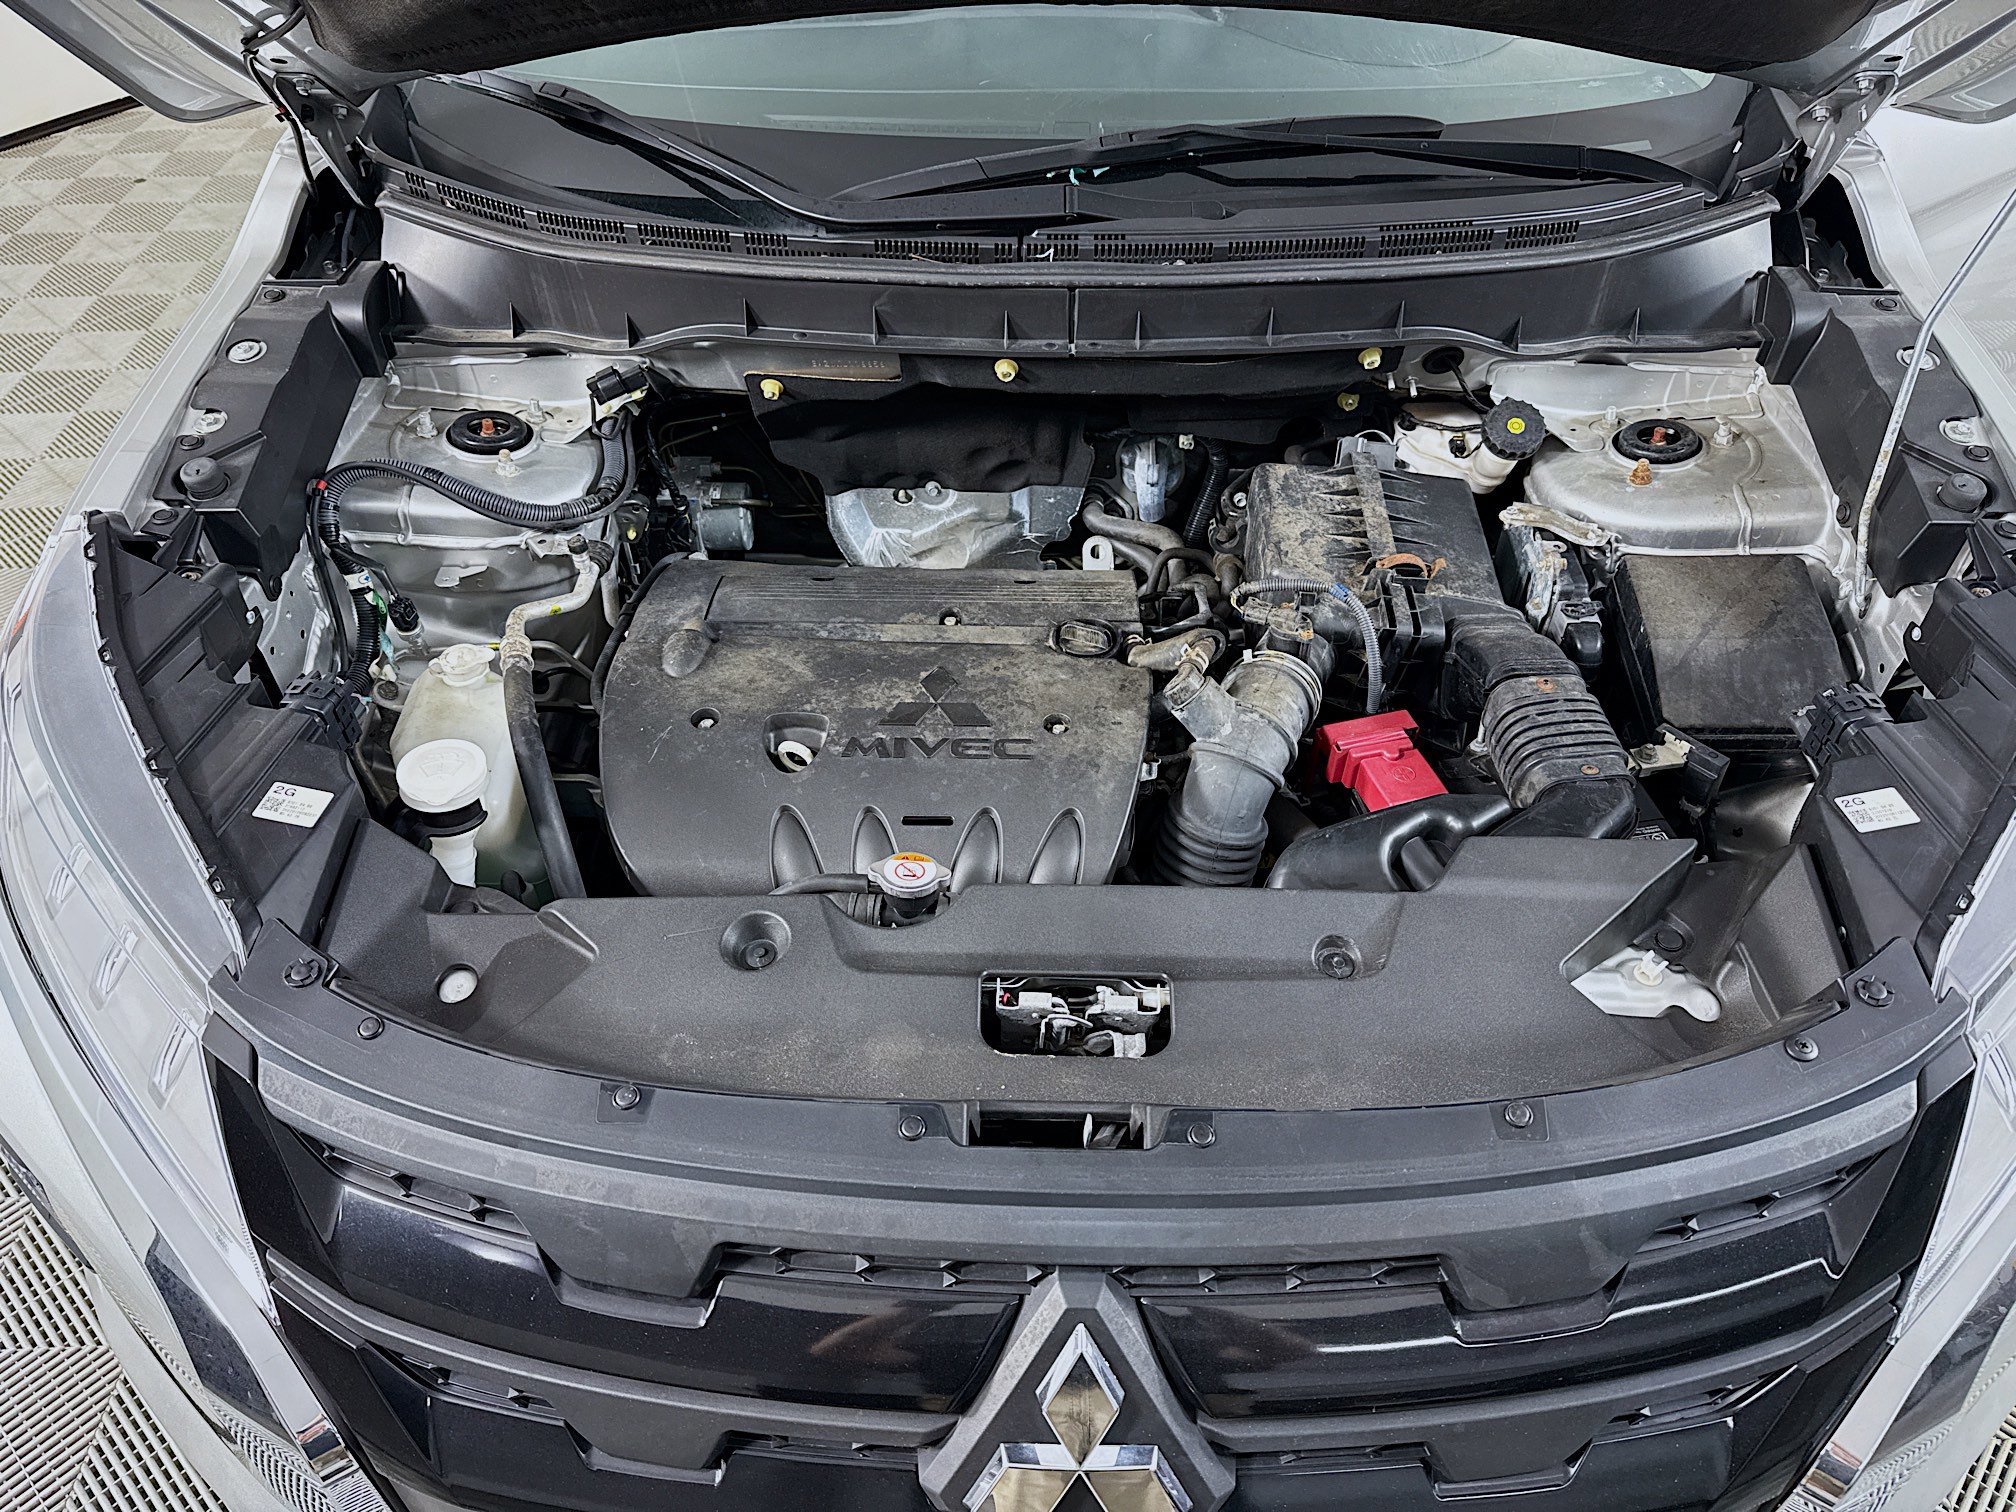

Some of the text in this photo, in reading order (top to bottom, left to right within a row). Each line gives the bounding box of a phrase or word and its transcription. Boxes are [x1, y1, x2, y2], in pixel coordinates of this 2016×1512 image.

[841, 736, 1034, 760] MIVEC
[273, 785, 297, 797] 2G
[1841, 797, 1866, 808] 2G
